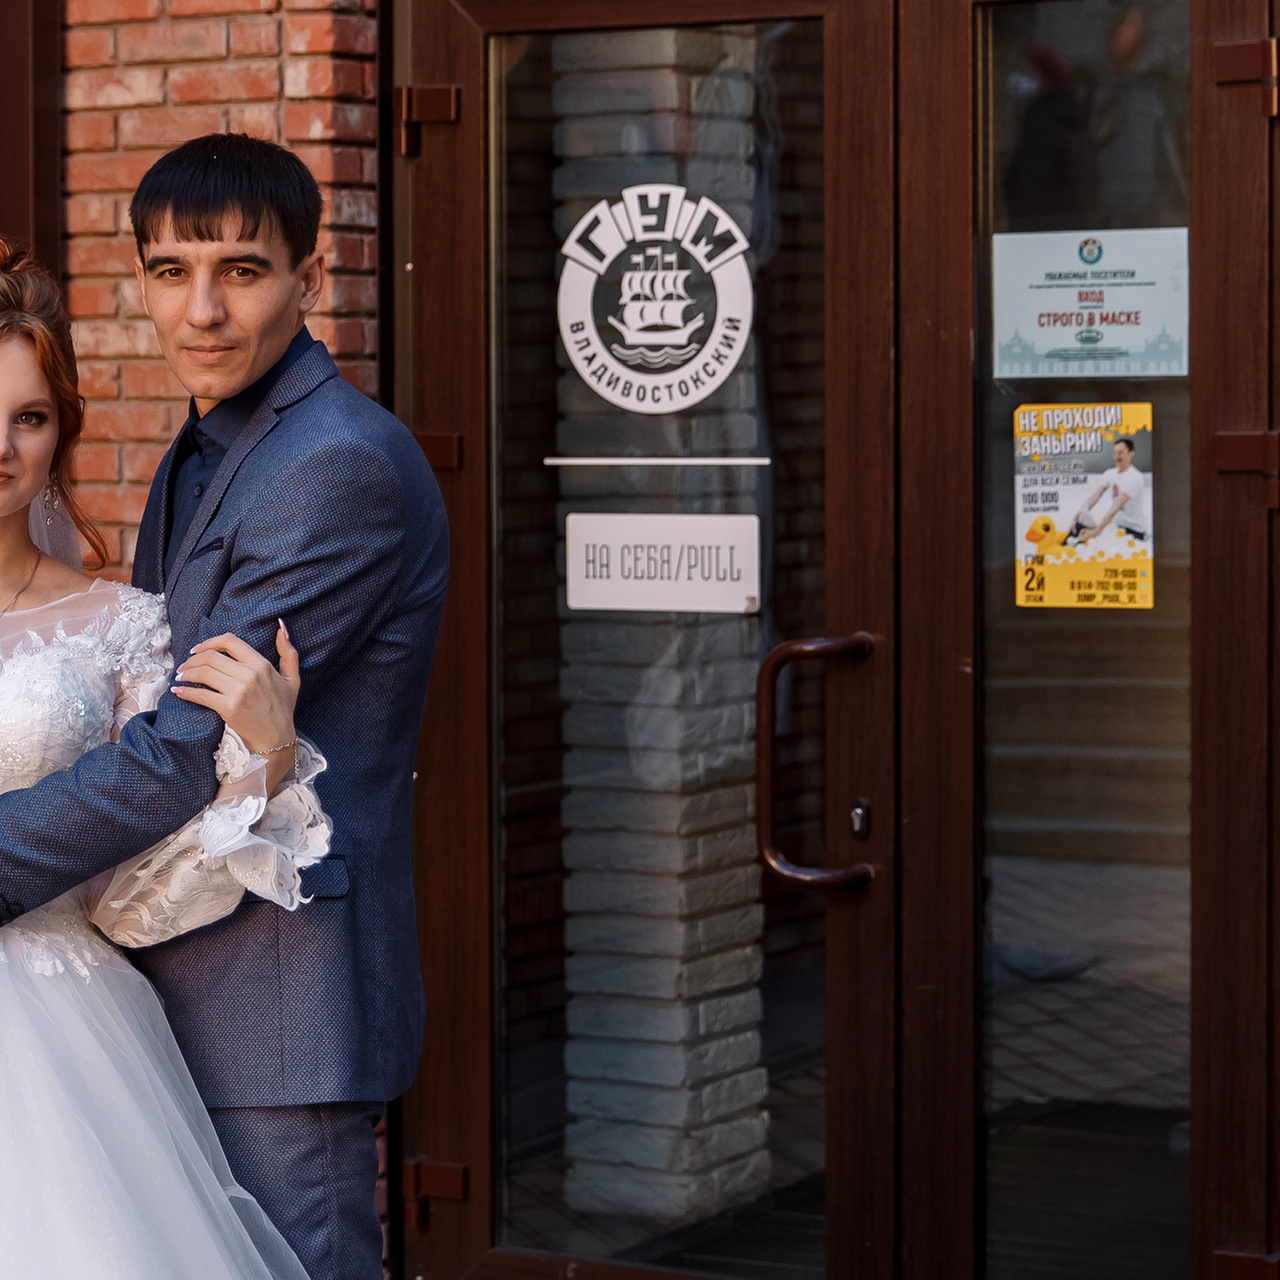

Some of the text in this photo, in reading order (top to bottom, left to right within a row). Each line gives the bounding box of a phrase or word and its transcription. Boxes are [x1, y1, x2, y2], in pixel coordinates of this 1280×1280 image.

[574, 191, 739, 265] ГУМ
[1077, 289, 1105, 304] ВХОД
[1037, 310, 1142, 328] СТРОГО В МАСКЕ
[569, 315, 742, 404] ВЛАДИВОСТОКСКИЙ
[1019, 404, 1122, 432] НЕ ПРОХОДИ!
[1020, 431, 1103, 457] ЗАНЫРНИ!
[584, 543, 742, 583] НА СЕБЯ/PULL
